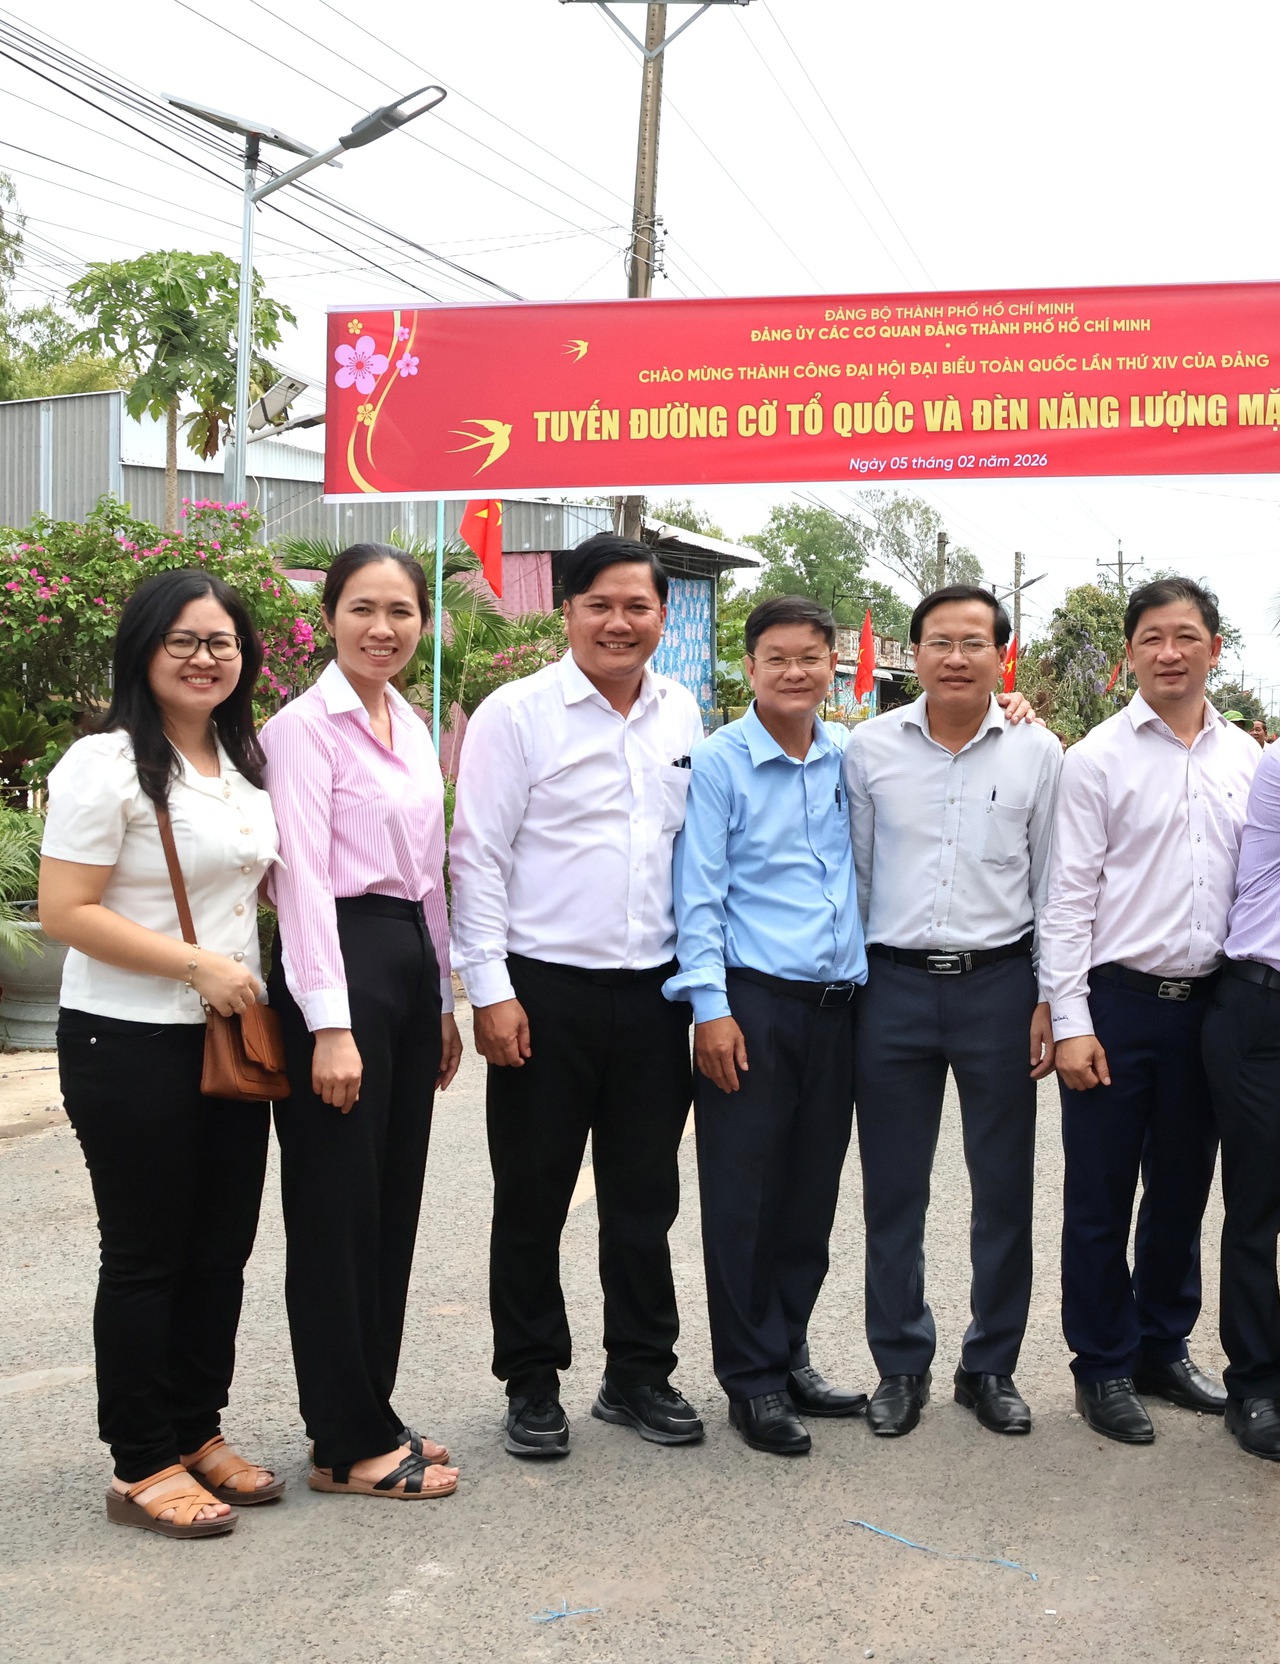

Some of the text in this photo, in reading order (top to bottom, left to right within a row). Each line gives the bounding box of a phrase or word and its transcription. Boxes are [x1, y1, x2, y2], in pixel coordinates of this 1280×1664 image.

[825, 301, 1074, 323] ĐẢNG BỘ THÀNH PHỐ HỒ CHÍ MINH
[750, 316, 1151, 342] ĐẢNG ỦY CÁC CƠ QUAN ĐẢNG THÀNH PHỐ HỒ CHÍ MINH
[638, 350, 1270, 383] CHÀO MỪNG THÀNH CÔNG ĐẠI HỘI ĐẠI BIỂU TOÀN QUỐC LẦN THỨ XIV CỦA ĐẢNG
[533, 399, 620, 442] TUYẾN
[629, 402, 728, 440] ĐƯỜNG
[737, 399, 778, 438] CỜ
[786, 392, 824, 436] TỔ
[833, 391, 914, 438] QUỐC
[922, 393, 963, 432] VÀ
[971, 394, 1028, 432] ĐÈN
[1039, 391, 1119, 430] NĂNG
[1130, 390, 1227, 433] LƯỢNG
[849, 454, 1048, 473] Ngày 05 tháng 02 năm 2026
